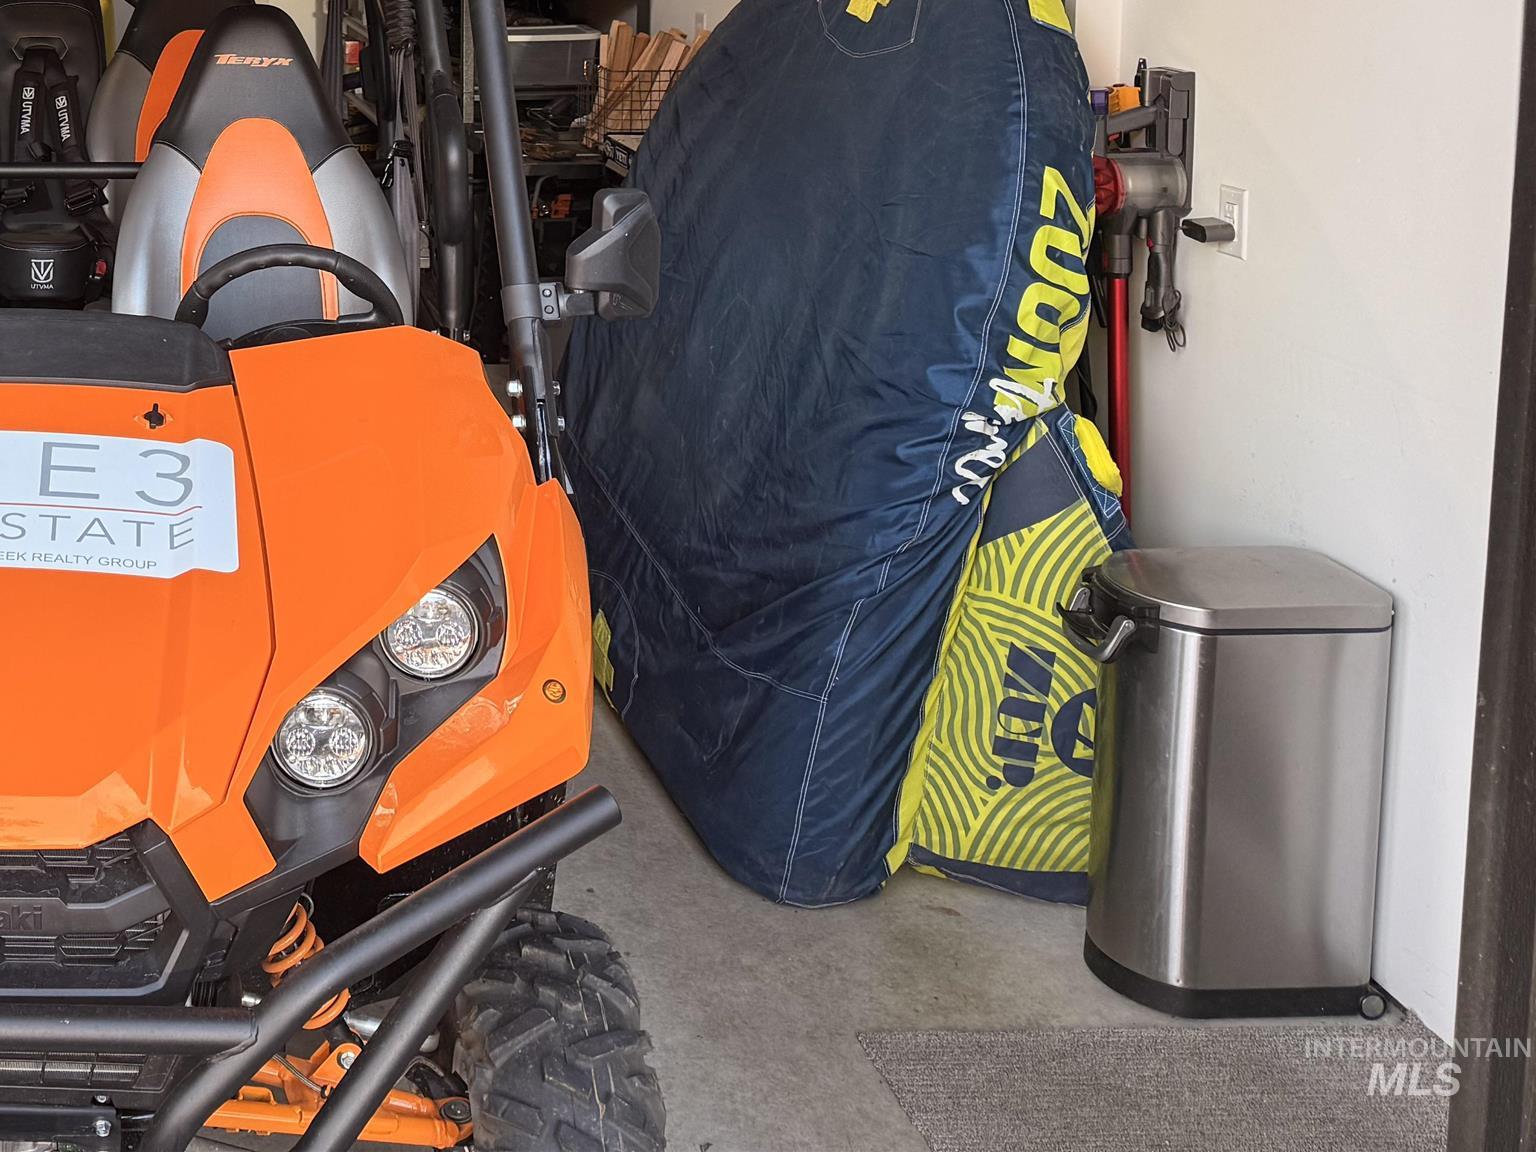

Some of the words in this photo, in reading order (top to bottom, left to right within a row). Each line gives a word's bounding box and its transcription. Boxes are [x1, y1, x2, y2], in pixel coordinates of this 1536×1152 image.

[20, 101, 33, 135] UTVMA
[58, 109, 71, 142] UTVMA
[31, 552, 93, 565] REALTY
[98, 556, 157, 569] GROUP
